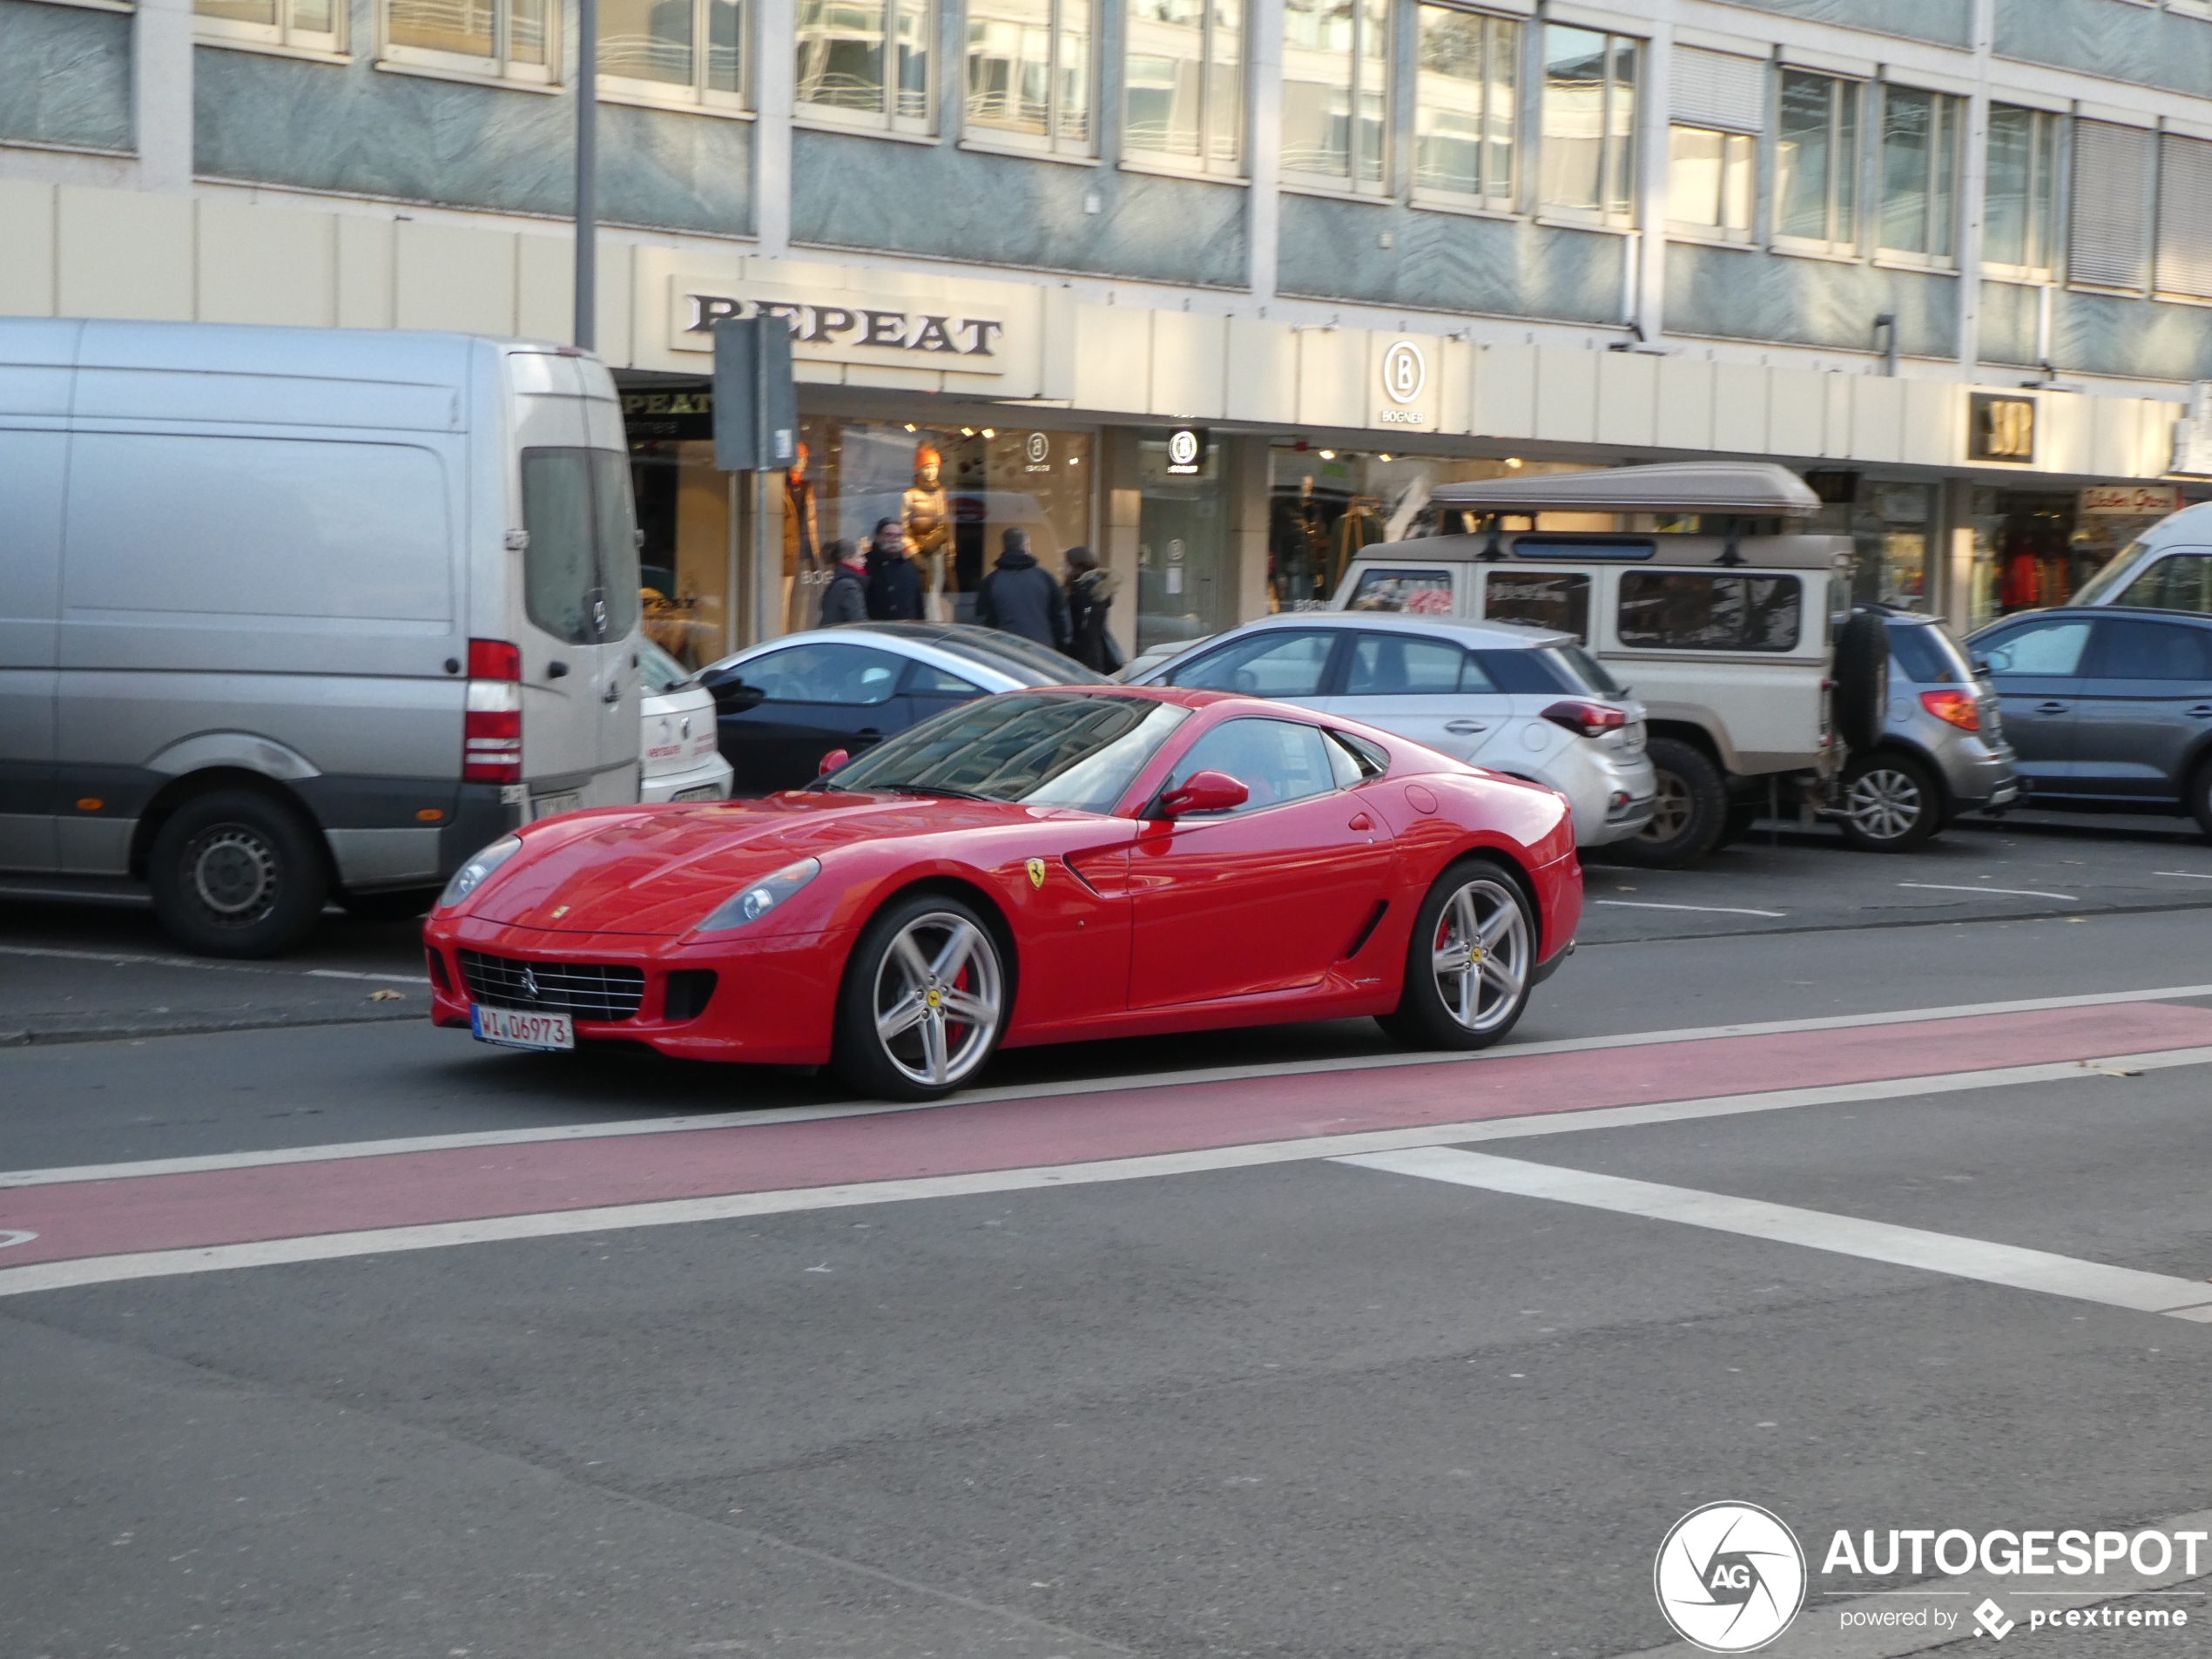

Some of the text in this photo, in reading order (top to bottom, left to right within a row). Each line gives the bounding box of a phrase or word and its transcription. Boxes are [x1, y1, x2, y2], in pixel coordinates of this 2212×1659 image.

[620, 394, 714, 414] PEAT
[1381, 410, 1424, 424] BOGNER
[509, 1015, 565, 1043] 06973
